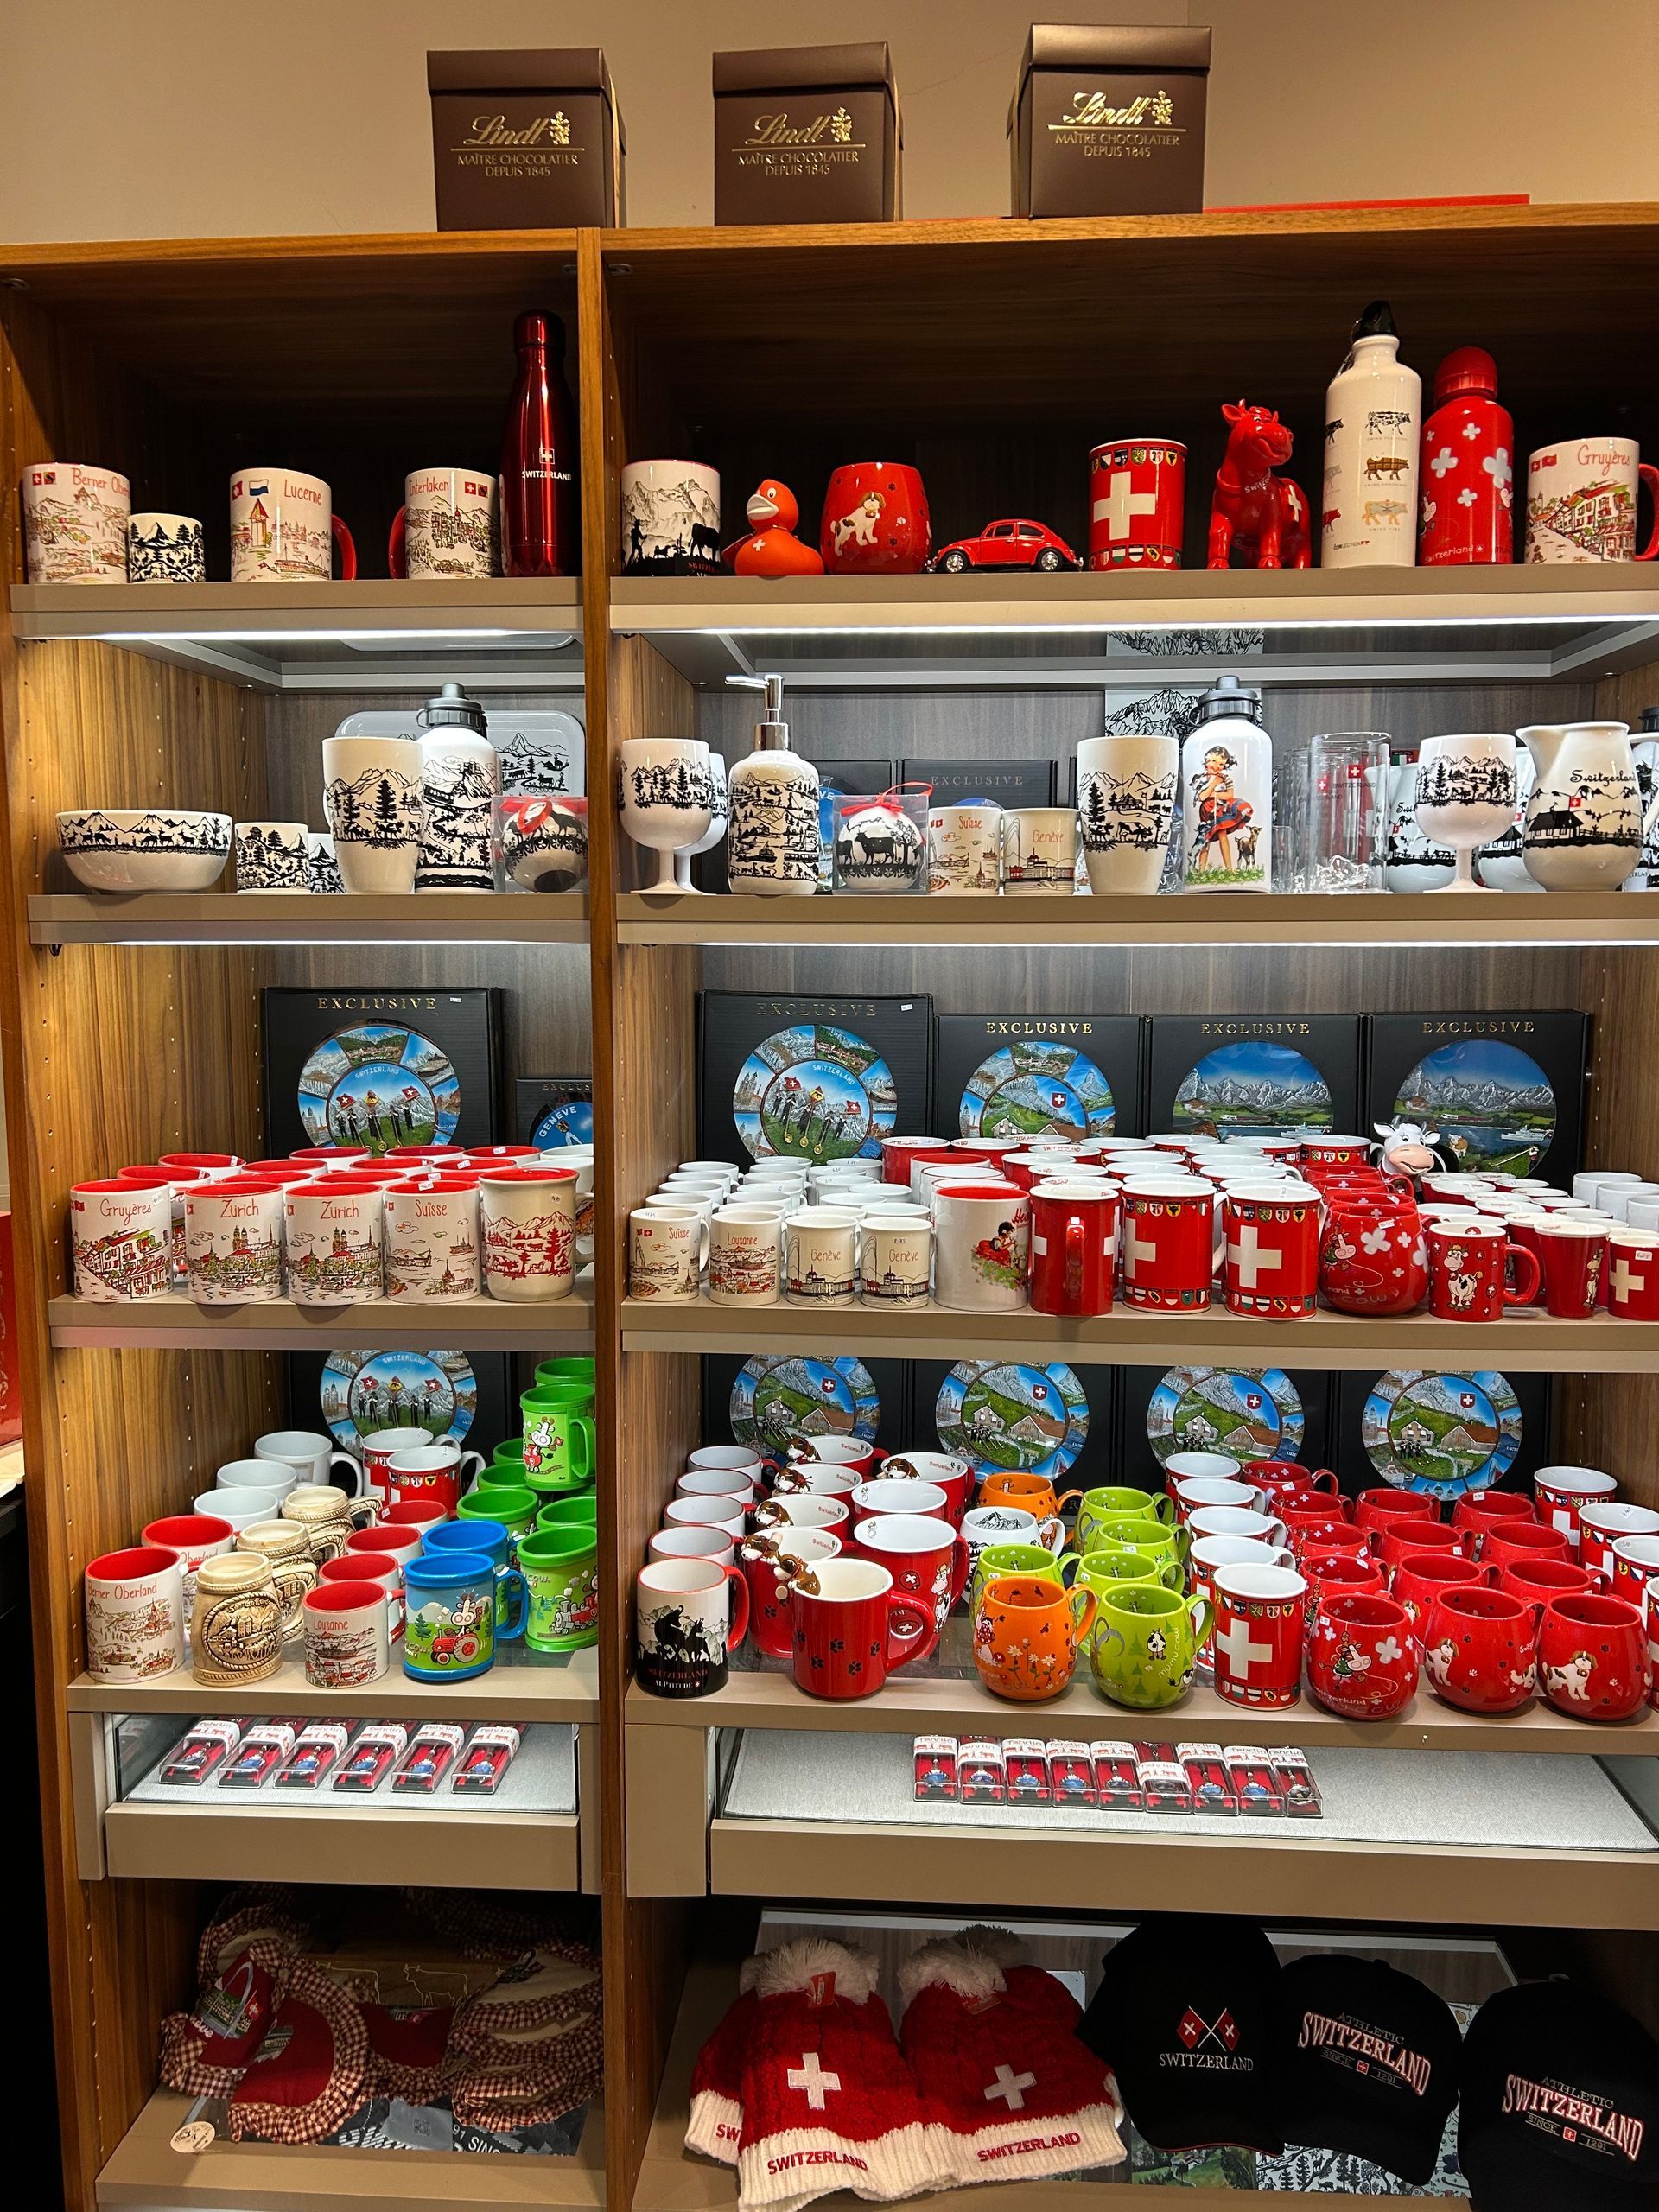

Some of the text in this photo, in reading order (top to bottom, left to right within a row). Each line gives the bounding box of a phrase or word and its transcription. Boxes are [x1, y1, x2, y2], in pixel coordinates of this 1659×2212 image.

[1062, 91, 1153, 125] Lindt
[463, 114, 550, 145] Lindt
[745, 113, 832, 145] Lindt
[1055, 131, 1179, 146] MAÎTRE CHOCOLATIER
[738, 151, 860, 165] MAÎTRE CHOCOLATIER
[1084, 145, 1151, 157] DEPUIS 1845
[457, 153, 579, 165] MAÎTRE CHOCOLATIER
[485, 166, 551, 177] DEPUIS 1845
[766, 164, 830, 176] DEPUIS 1845
[1577, 444, 1631, 476] Gruyères
[71, 467, 109, 491] Berner
[521, 470, 572, 481] SWITZERLAND
[283, 479, 322, 506] Lucerne
[408, 479, 449, 496] Interlaken
[931, 775, 1024, 785] EXCLUSIVE
[958, 815, 982, 830] Suisse
[1033, 829, 1065, 844] Genève
[317, 997, 437, 1010] EXCLUSIVE
[756, 1002, 876, 1016] EXCLUSIVE
[986, 1022, 1093, 1034] EXCLUSIVE
[1201, 1022, 1310, 1035] EXCLUSIVE
[1422, 1021, 1535, 1033] EXCLUSIVE
[354, 1066, 400, 1079] SWITZERLAND
[812, 1064, 855, 1085] SWITZERLAND
[99, 1198, 152, 1226] Gruyères
[416, 1198, 448, 1217] Suisse
[668, 1226, 690, 1240] Suisse
[727, 1231, 758, 1246] Lausanne
[810, 1249, 842, 1262] Genève
[888, 1249, 918, 1262] Genève
[383, 1351, 426, 1366] SWITZERLAND
[86, 1580, 158, 1600] Berner Oberland
[314, 1615, 349, 1630] Lausanne
[647, 1667, 709, 1679] SWITZERLAND
[1336, 2012, 1405, 2045] ATHLETIC
[1297, 2011, 1431, 2096] SWITZERLAND
[1322, 2049, 1351, 2066] SINCE
[1159, 2053, 1254, 2071] SWITZERLAND
[1540, 2075, 1614, 2109] ATHLETIC
[1502, 2074, 1644, 2161] SWITZERLAND
[1528, 2114, 1557, 2134] SINCE
[977, 2132, 1081, 2162] SWITZERLAND
[767, 2150, 868, 2175] SWITZERLAND
